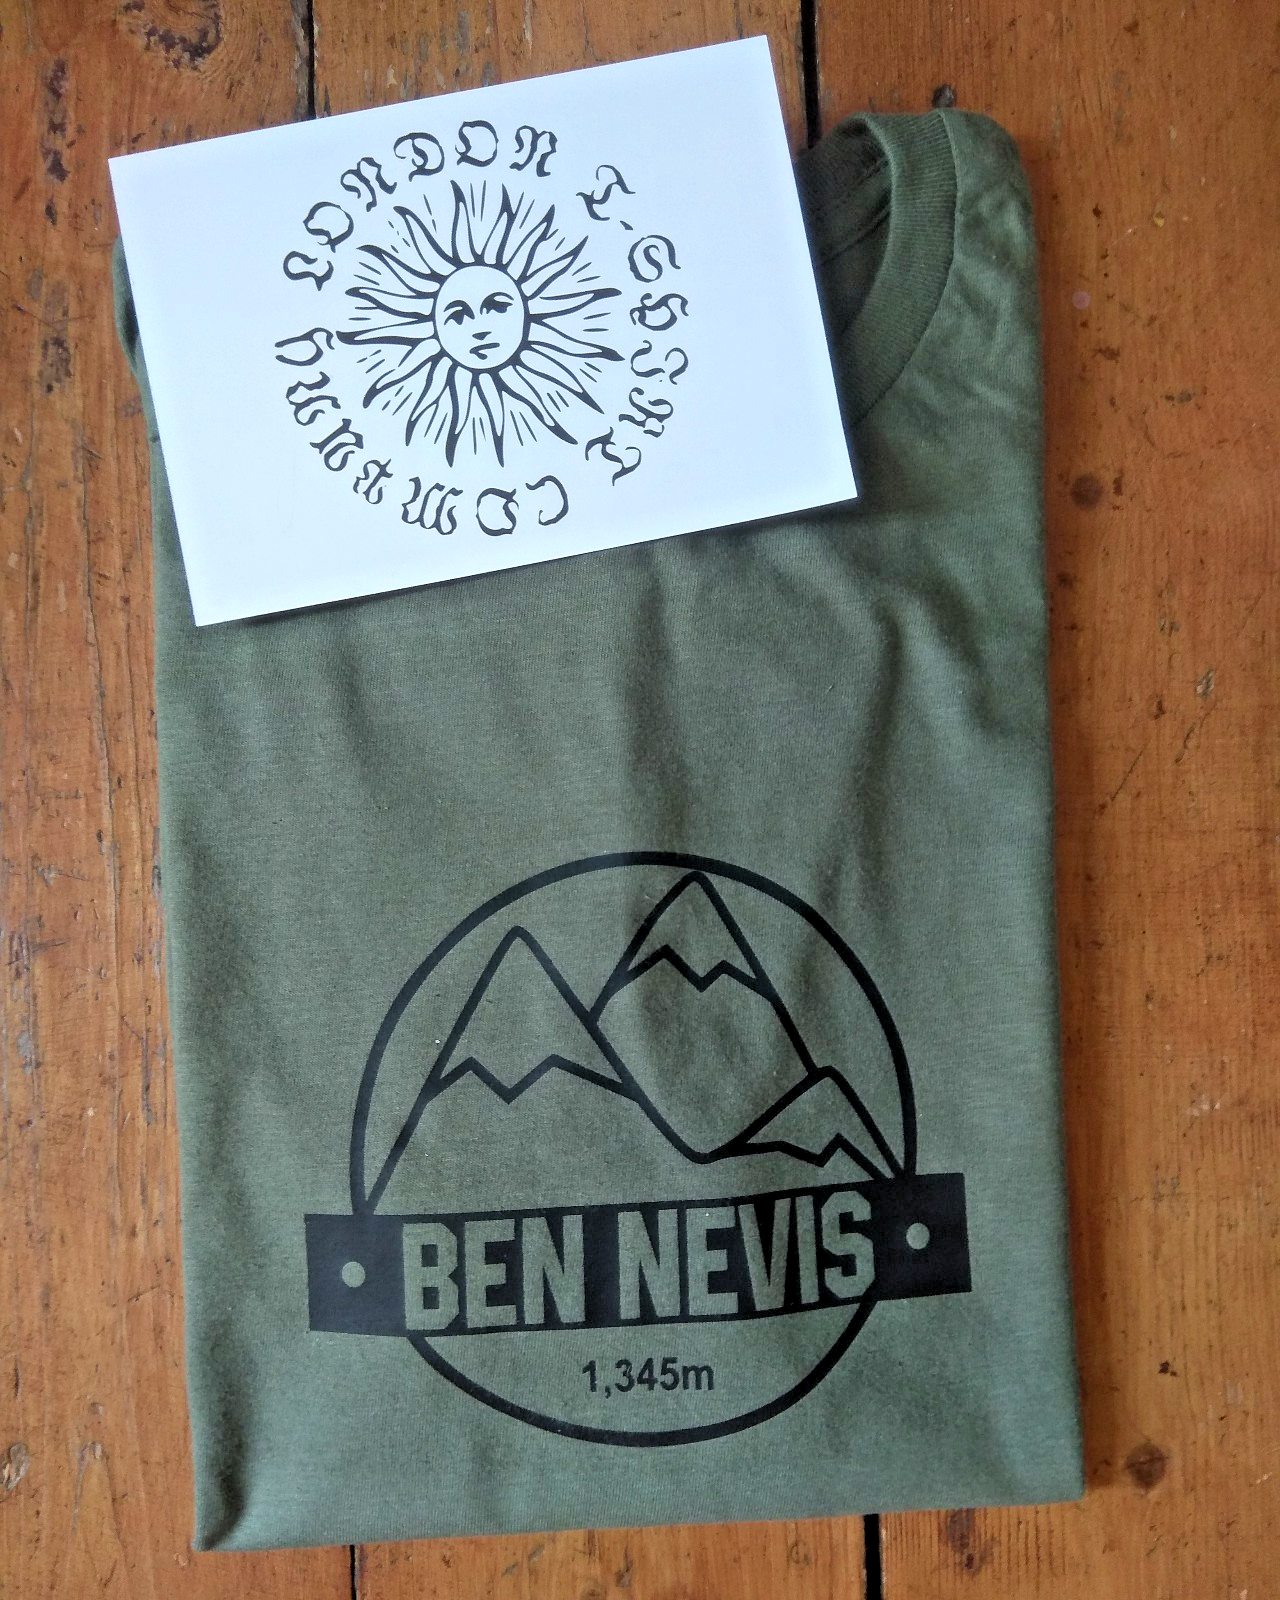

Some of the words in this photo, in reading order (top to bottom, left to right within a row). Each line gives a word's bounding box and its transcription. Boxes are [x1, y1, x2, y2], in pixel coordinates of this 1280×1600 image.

[283, 120, 557, 291] LONDON
[576, 165, 689, 487] T-SHIRT
[275, 328, 568, 537] COMPANY
[403, 1213, 586, 1331] BEN
[617, 1190, 875, 1320] NEVIS
[581, 1357, 714, 1398] 1,345m
